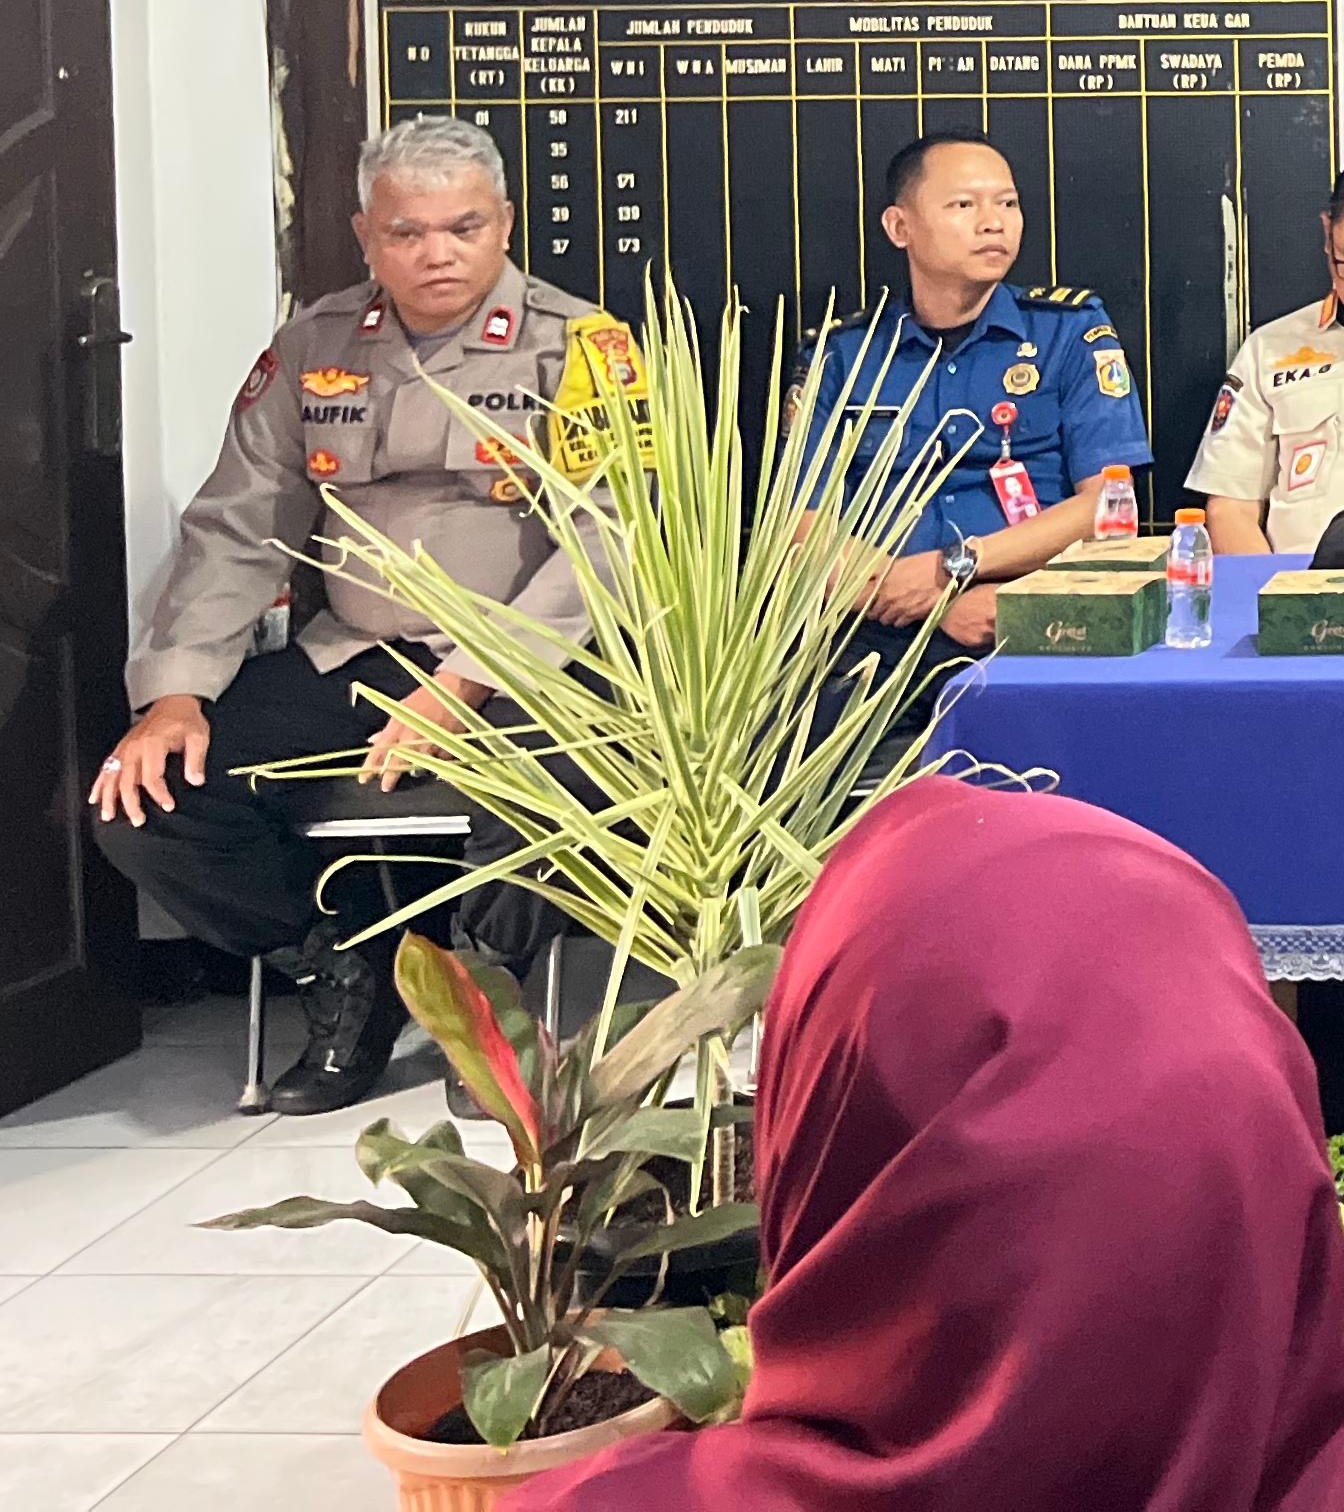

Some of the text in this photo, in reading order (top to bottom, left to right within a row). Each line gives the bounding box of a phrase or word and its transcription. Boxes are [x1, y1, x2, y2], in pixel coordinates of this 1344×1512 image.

[465, 21, 506, 36] RUKUN
[531, 17, 586, 32] JUMLAH
[627, 19, 753, 35] JUMLAH PENDUDUK
[850, 16, 993, 32] MOBILITAS PENDUDUK
[1119, 13, 1176, 29] BANTUAN
[531, 37, 581, 52] KEPALA
[455, 46, 520, 61] TETANGGA
[1160, 53, 1223, 69] SWADAYA
[1258, 53, 1305, 69] PEMDA
[524, 57, 590, 73] KELUARGA
[725, 58, 786, 73] MUSIMAN
[806, 57, 843, 73] LAHIR
[871, 57, 905, 72] MATI
[990, 55, 1040, 71] DATANG
[1058, 54, 1137, 70] DANA PPMK
[470, 70, 504, 85] (RT)
[1079, 74, 1114, 91] (RP)
[1173, 73, 1208, 90] (RP)
[1266, 72, 1302, 89] (RP)
[615, 109, 638, 125] 211
[551, 142, 568, 158] 35
